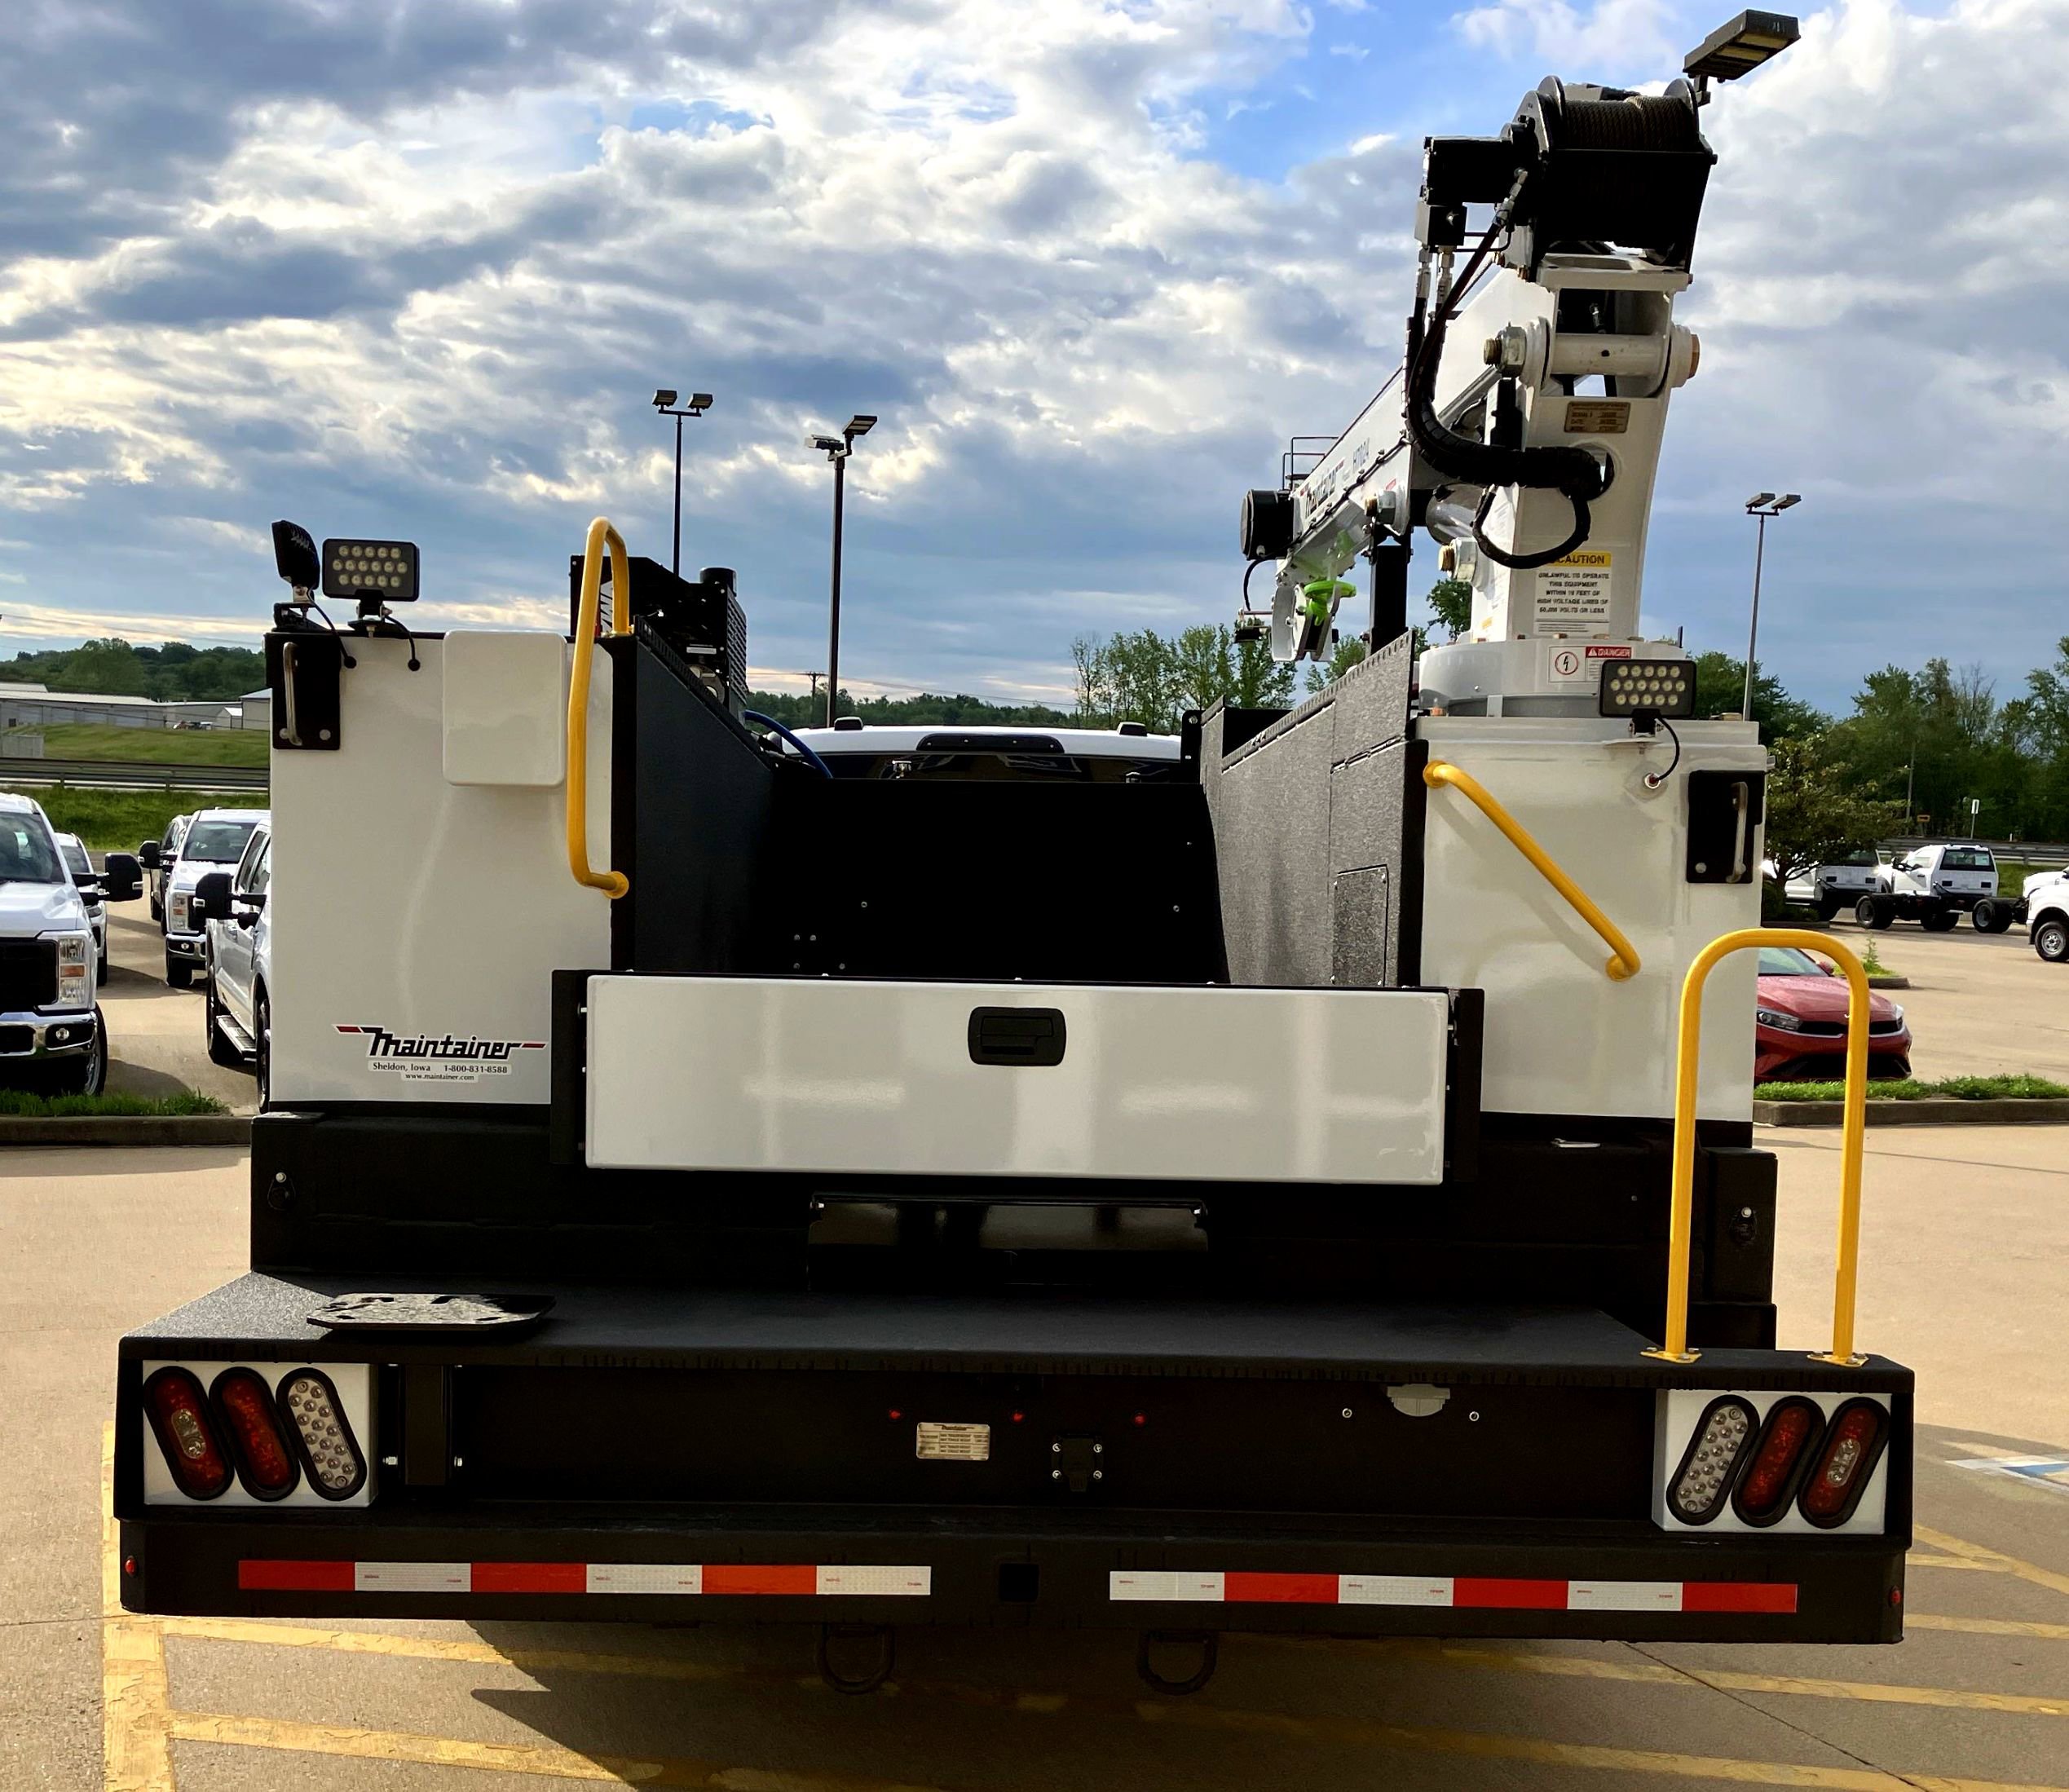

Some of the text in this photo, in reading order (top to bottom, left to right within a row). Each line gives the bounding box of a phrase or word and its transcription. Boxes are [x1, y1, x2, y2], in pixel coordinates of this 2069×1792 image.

[1597, 648, 1631, 657] DANGER
[362, 1026, 523, 1059] Maintainer
[373, 1062, 408, 1072] Sheldon,
[444, 1065, 508, 1074] 1-800-831-8588
[405, 1073, 474, 1081] www.maintainer.com
